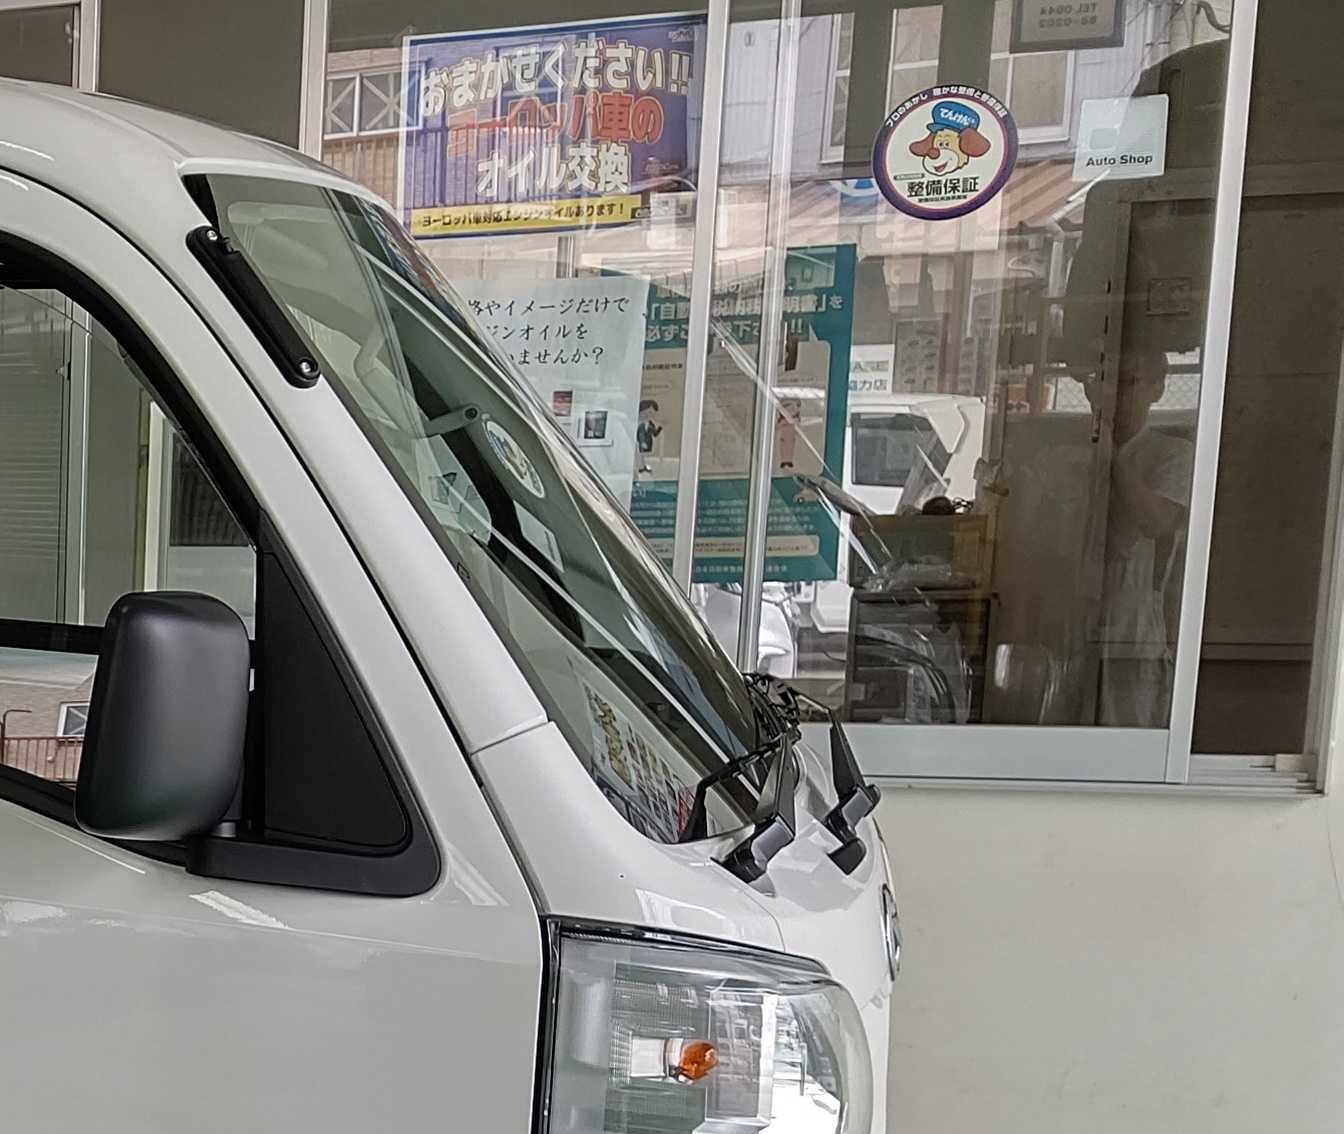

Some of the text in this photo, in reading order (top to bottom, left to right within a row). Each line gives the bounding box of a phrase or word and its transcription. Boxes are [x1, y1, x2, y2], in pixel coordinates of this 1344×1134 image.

[476, 141, 631, 196] オイル交換
[1086, 154, 1153, 168] Auto Shop
[907, 177, 980, 197] 整備保証
[510, 346, 604, 365] ませんか?
